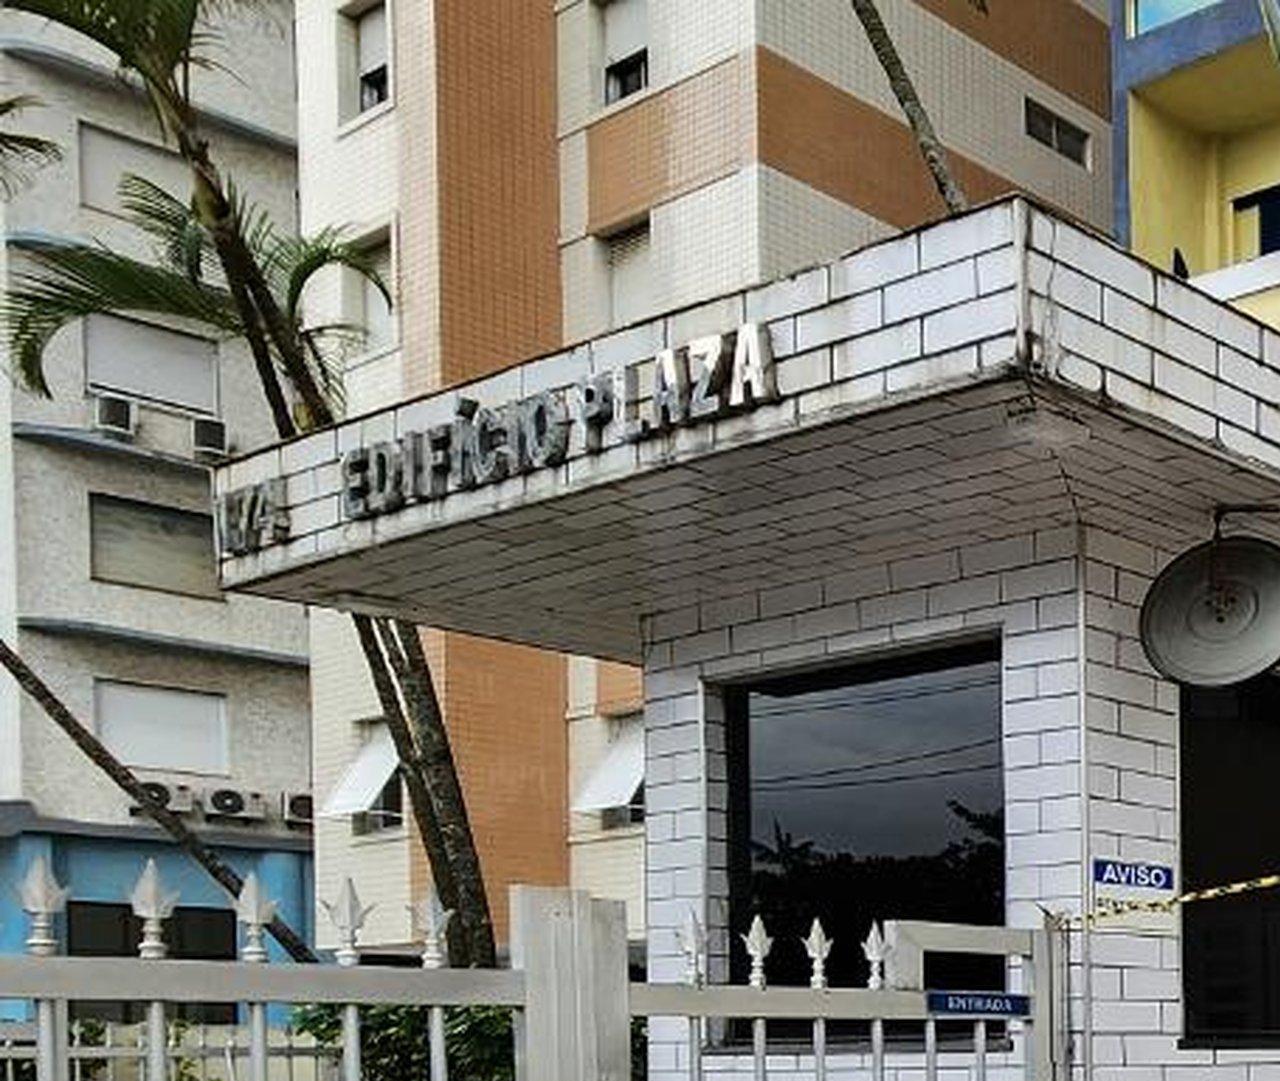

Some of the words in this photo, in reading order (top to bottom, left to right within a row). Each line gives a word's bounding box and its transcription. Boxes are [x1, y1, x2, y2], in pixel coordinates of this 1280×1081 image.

[580, 322, 776, 452] PLAZA
[1102, 863, 1168, 888] AVISO
[948, 996, 1013, 1012] ENTRADA
